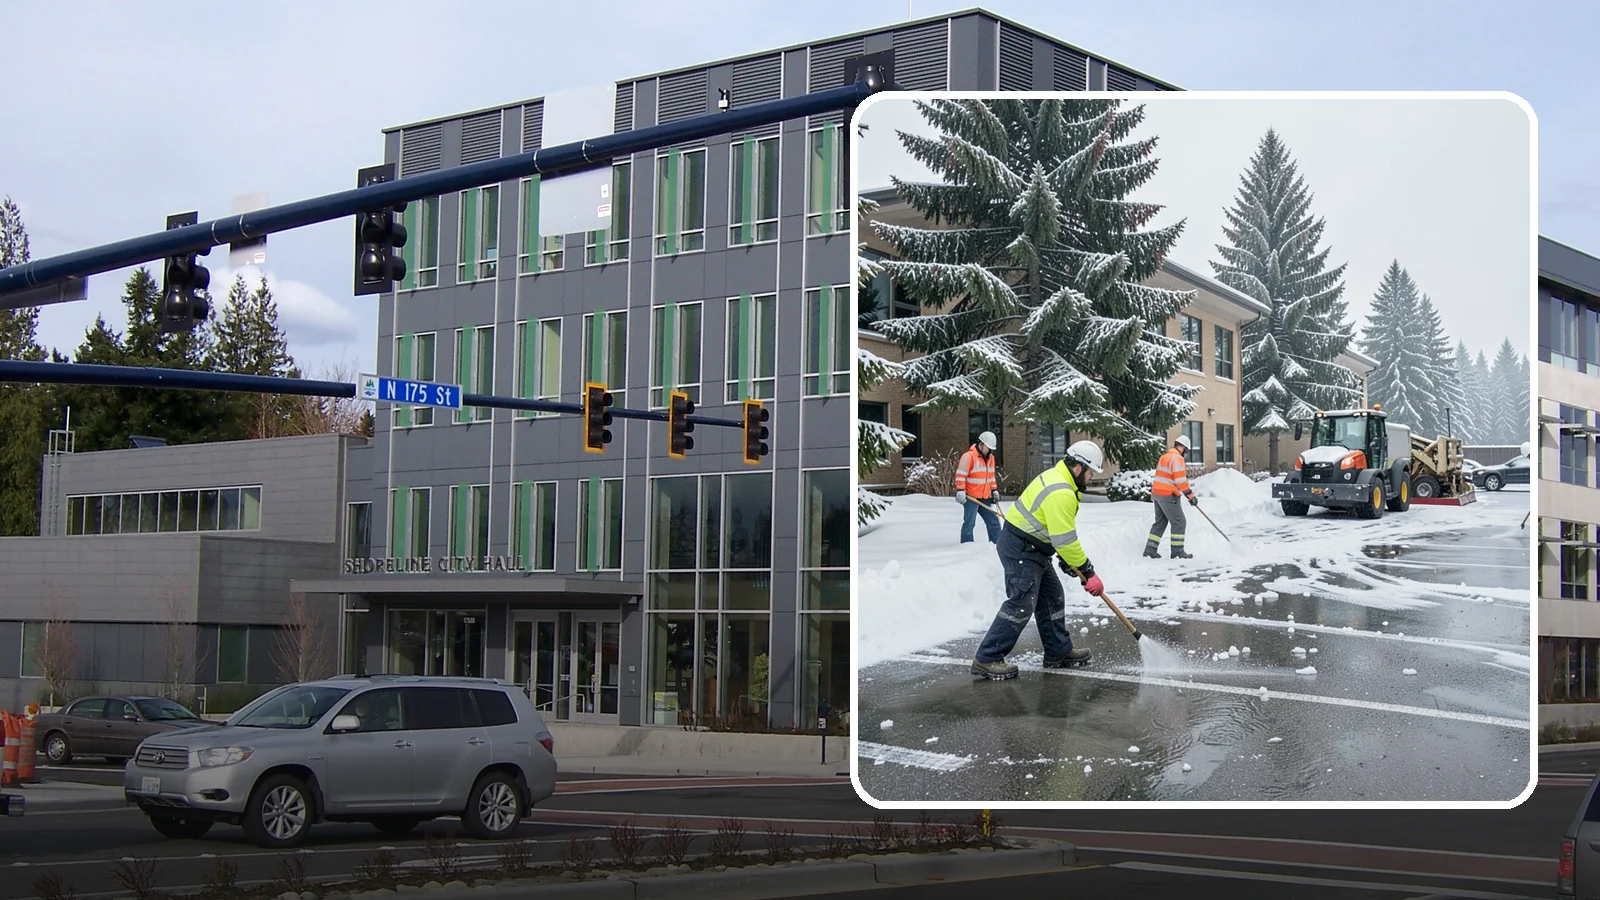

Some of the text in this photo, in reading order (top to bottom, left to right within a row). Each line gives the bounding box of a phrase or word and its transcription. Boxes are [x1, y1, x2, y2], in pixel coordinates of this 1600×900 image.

[387, 380, 451, 406] N 175 St
[344, 556, 525, 573] SHORELINE CITY HALL
